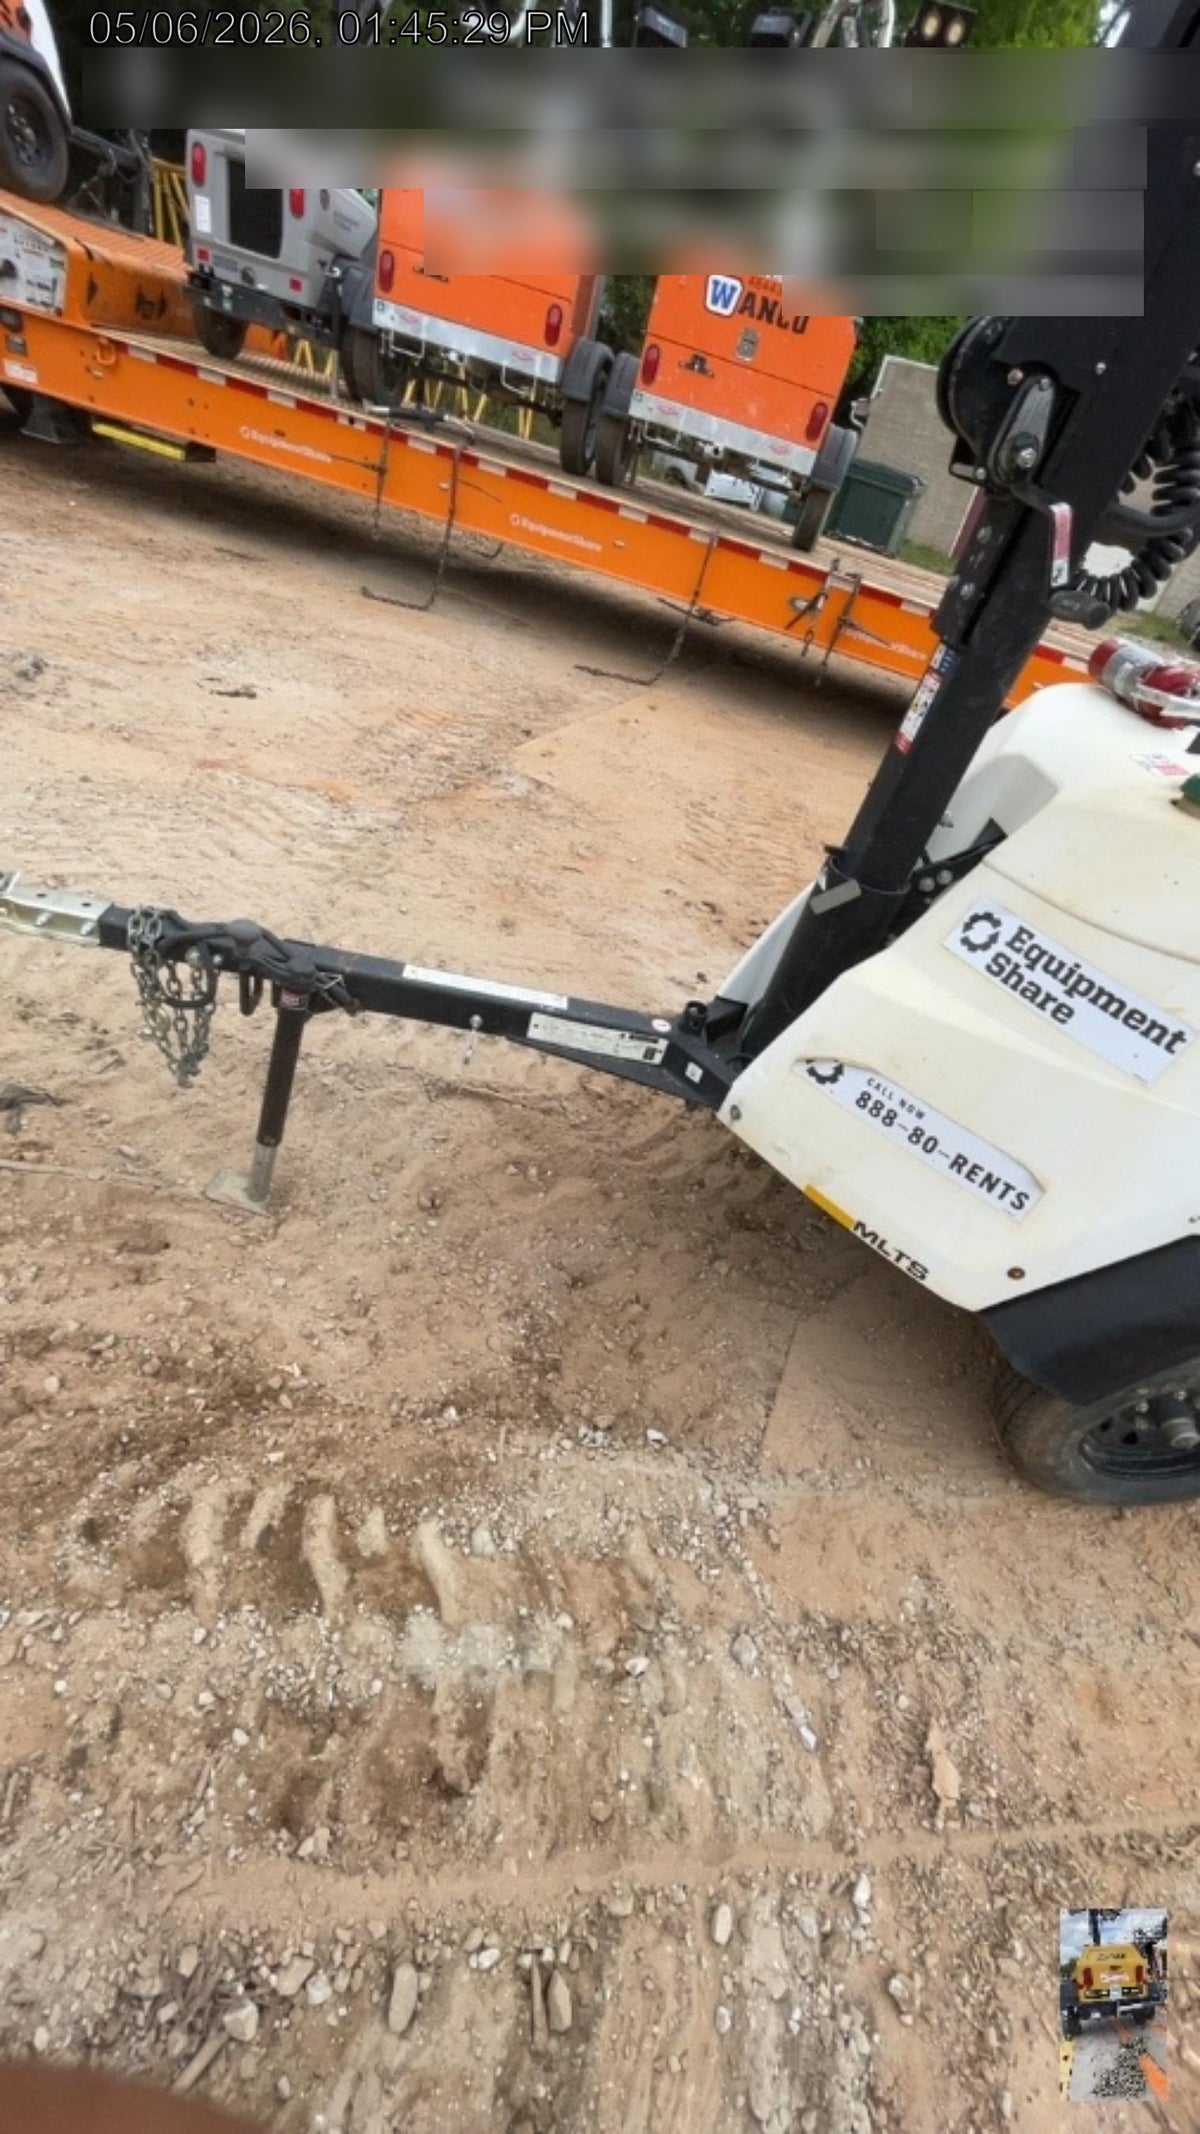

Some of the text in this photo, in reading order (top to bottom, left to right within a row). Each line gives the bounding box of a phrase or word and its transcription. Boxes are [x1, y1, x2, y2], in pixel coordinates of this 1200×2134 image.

[985, 952, 1075, 1025] Share
[1005, 926, 1187, 1054] Equipment
[867, 1077, 926, 1120] CALL NOW
[855, 1091, 1030, 1211] 888-80-RENTS
[853, 1220, 930, 1281] MLTS
